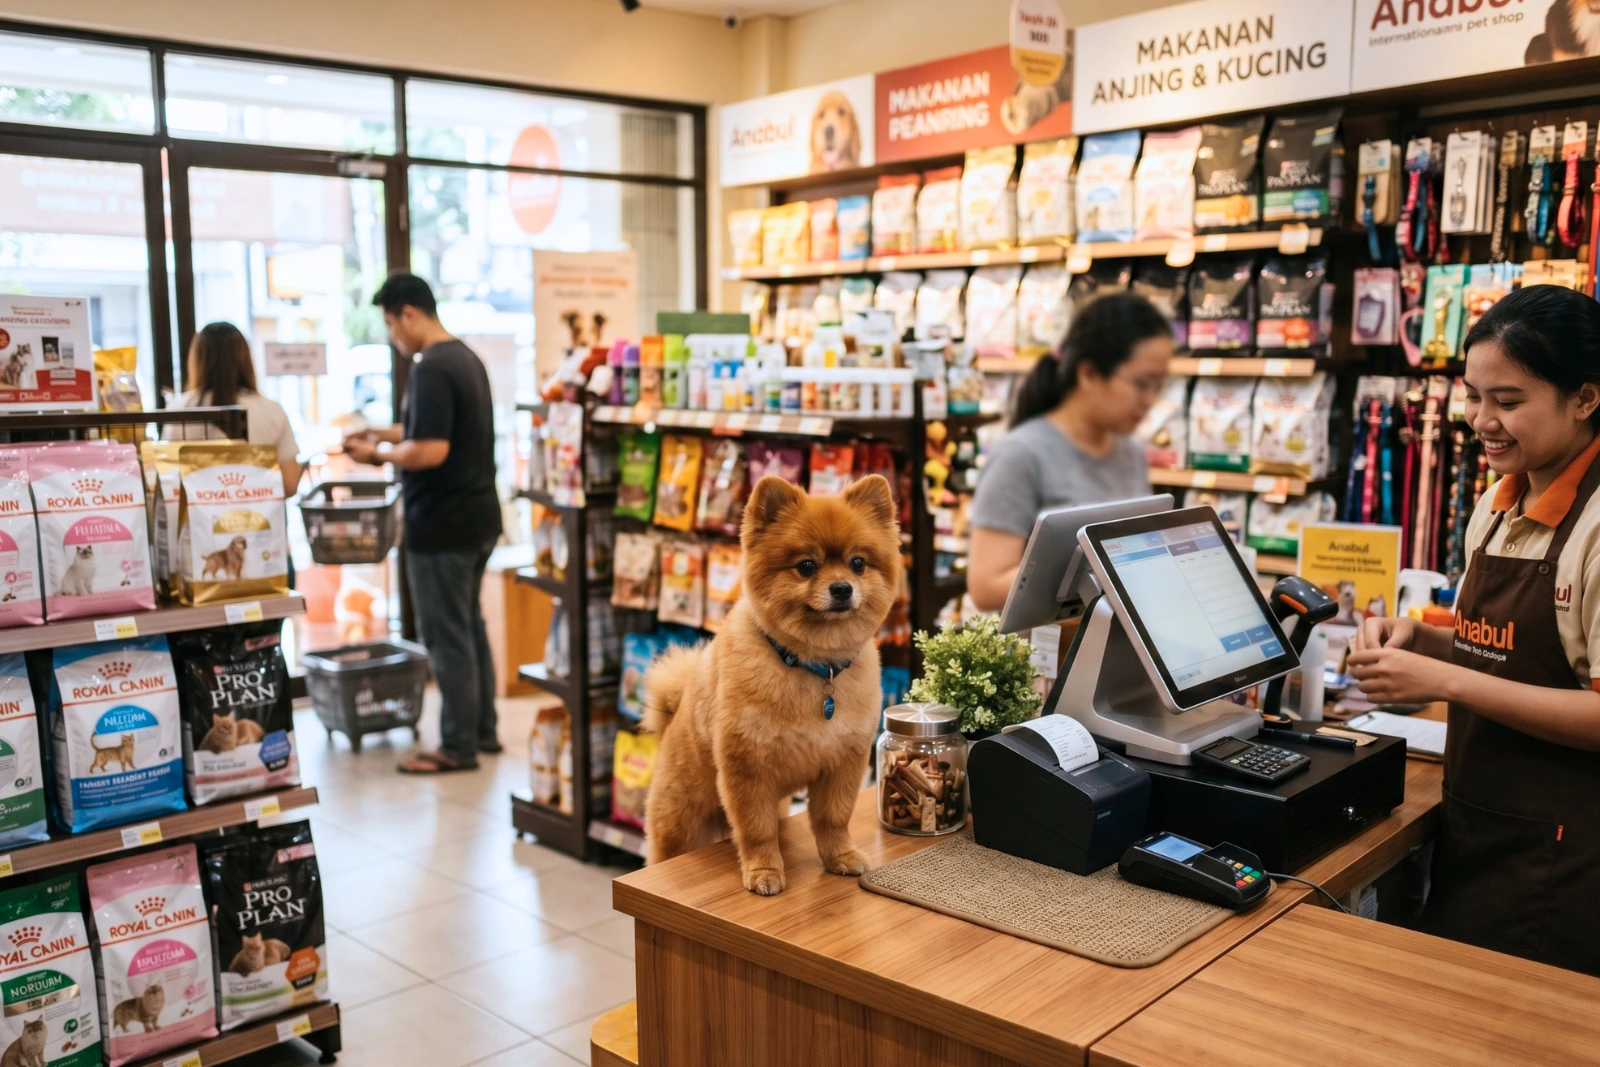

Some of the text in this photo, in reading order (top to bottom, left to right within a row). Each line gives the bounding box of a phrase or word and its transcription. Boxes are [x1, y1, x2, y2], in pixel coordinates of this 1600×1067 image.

[1467, 17, 1488, 33] pet
[1492, 11, 1524, 26] shop
[1137, 14, 1274, 65] MAKANAN
[1091, 42, 1327, 105] ANJING & KUCING
[889, 72, 991, 114] MAKANAN
[47, 493, 134, 508] ROYAL CANIN
[196, 486, 273, 500] ROYAL CANIN
[1328, 540, 1369, 554] Anabul
[1454, 609, 1514, 650] Anabul
[73, 675, 164, 700] ROYAL CANIN
[215, 670, 263, 691] PRO
[210, 682, 276, 709] PLAN
[243, 885, 292, 910] PRO
[109, 907, 196, 939] ROYAL CANIN
[237, 898, 307, 930] PLAN
[31, 935, 76, 958] CANIN
